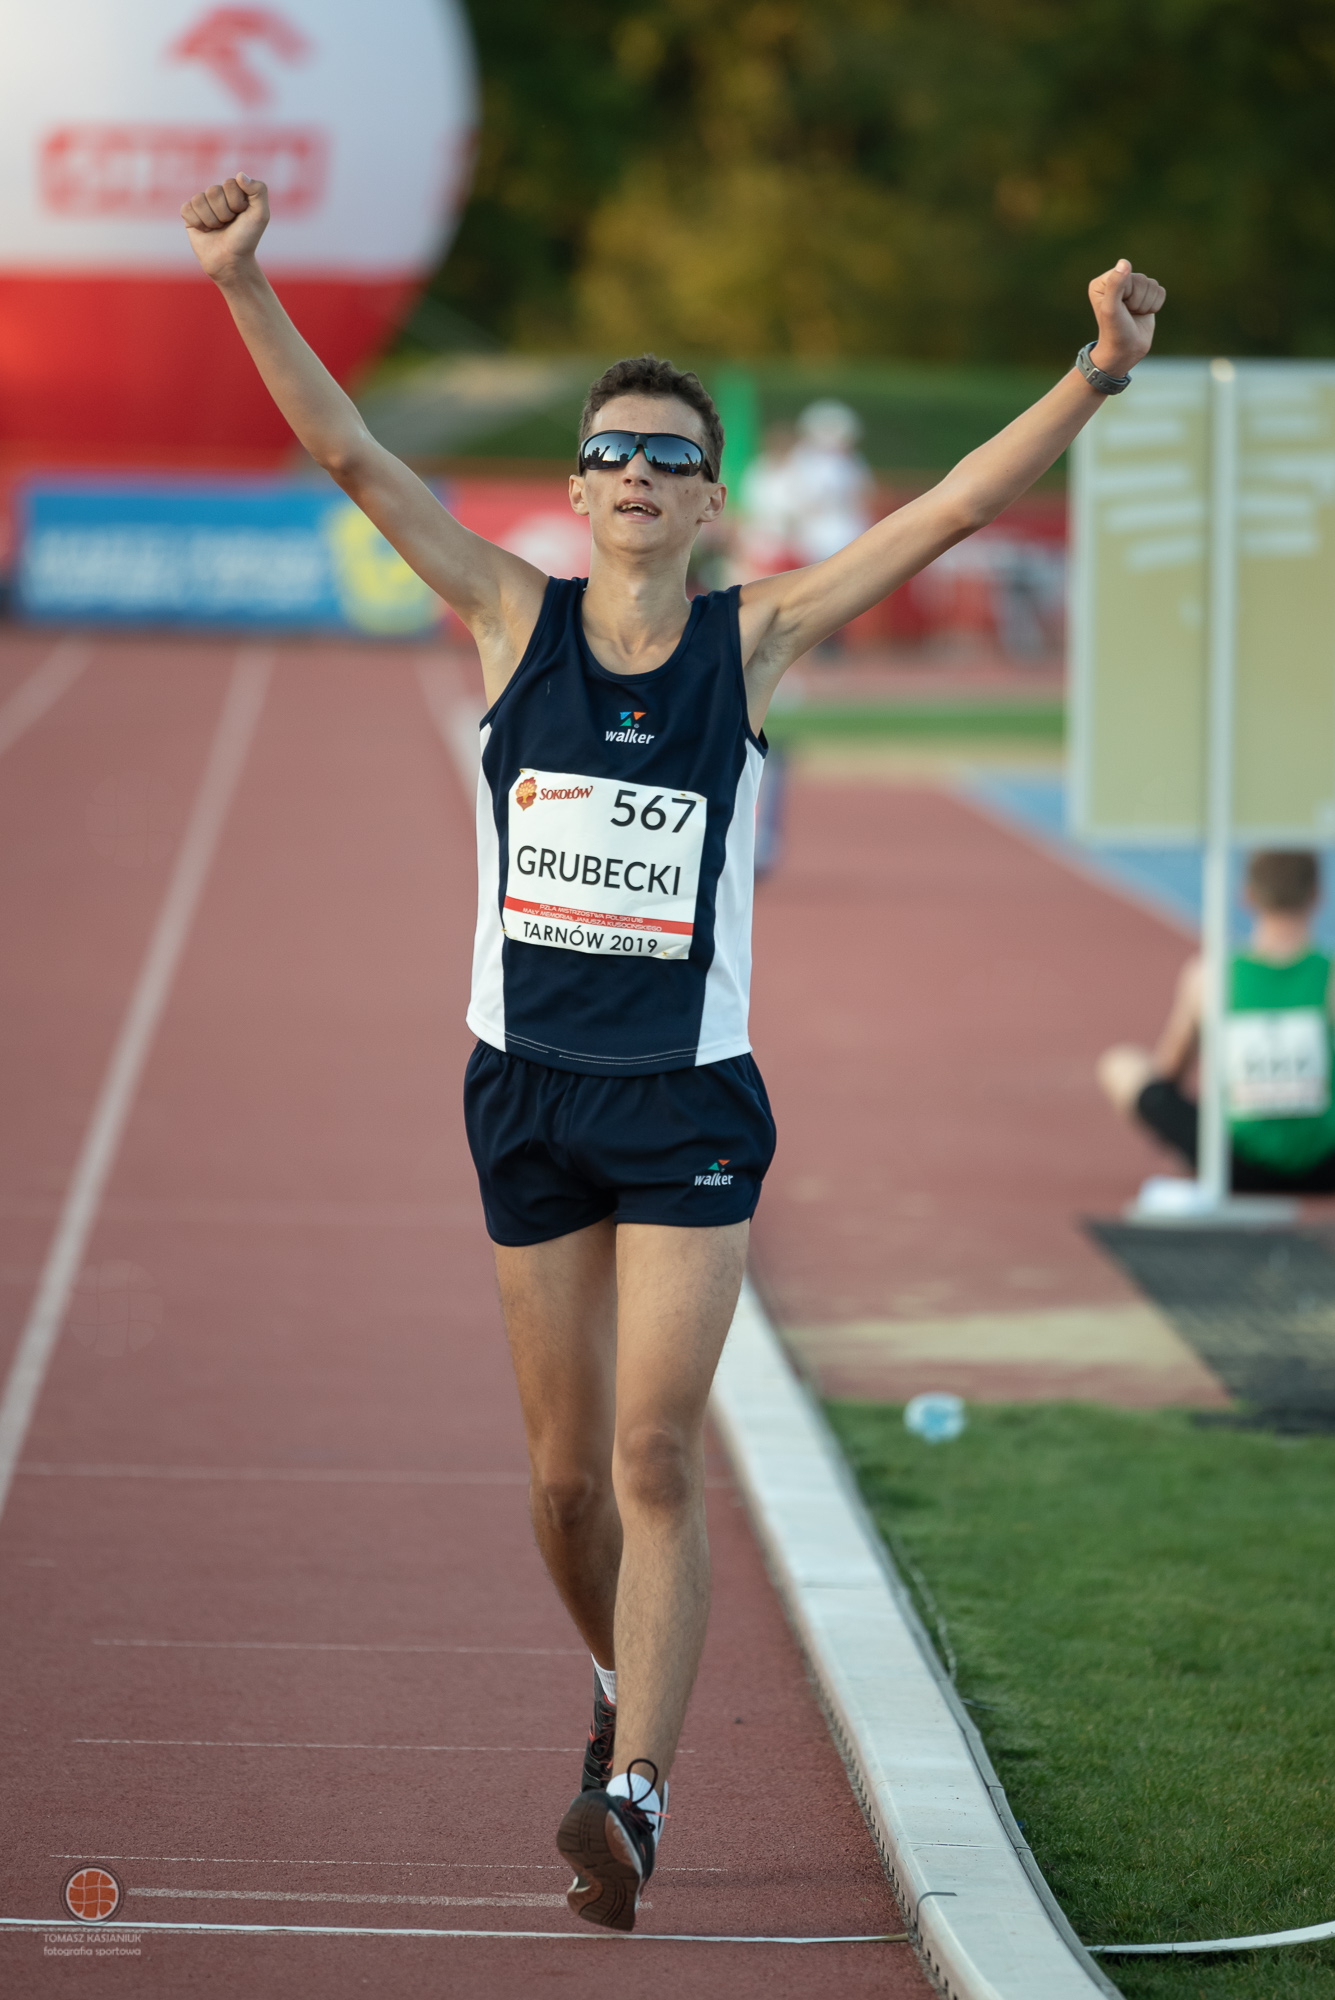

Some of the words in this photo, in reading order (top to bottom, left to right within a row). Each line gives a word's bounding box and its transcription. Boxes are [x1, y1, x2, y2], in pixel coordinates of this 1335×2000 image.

[605, 728, 655, 744] walker
[539, 785, 593, 800] SOKOŁÓW
[610, 789, 697, 833] 567
[516, 845, 681, 896] GRUBECKI
[522, 907, 540, 915] MAŁY
[575, 917, 606, 926] JANUSZA
[558, 907, 604, 919] MISTRZOSTWA
[605, 914, 630, 922] POLSKI
[523, 921, 604, 949] TARNÓW
[610, 934, 658, 953] 2019
[694, 1172, 733, 1186] walker
